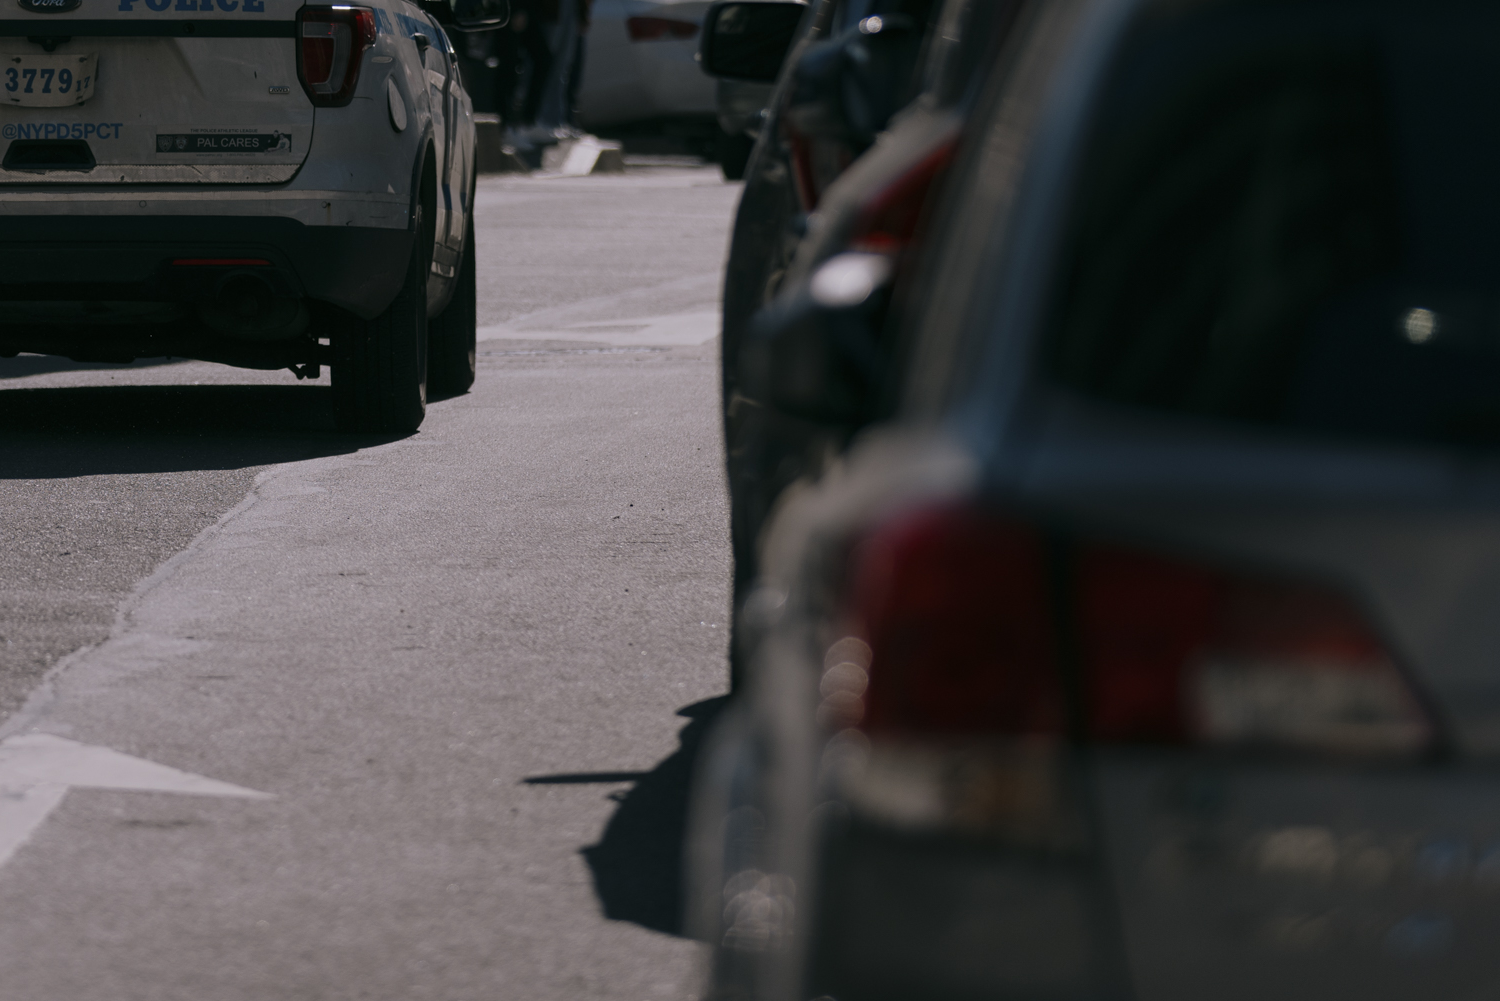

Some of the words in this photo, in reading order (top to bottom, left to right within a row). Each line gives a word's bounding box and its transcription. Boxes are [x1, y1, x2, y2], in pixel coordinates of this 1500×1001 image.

[5, 68, 73, 93] 3779
[2, 123, 123, 139] @NYPD5PCT
[197, 138, 218, 148] PAL
[220, 138, 260, 148] CARES
